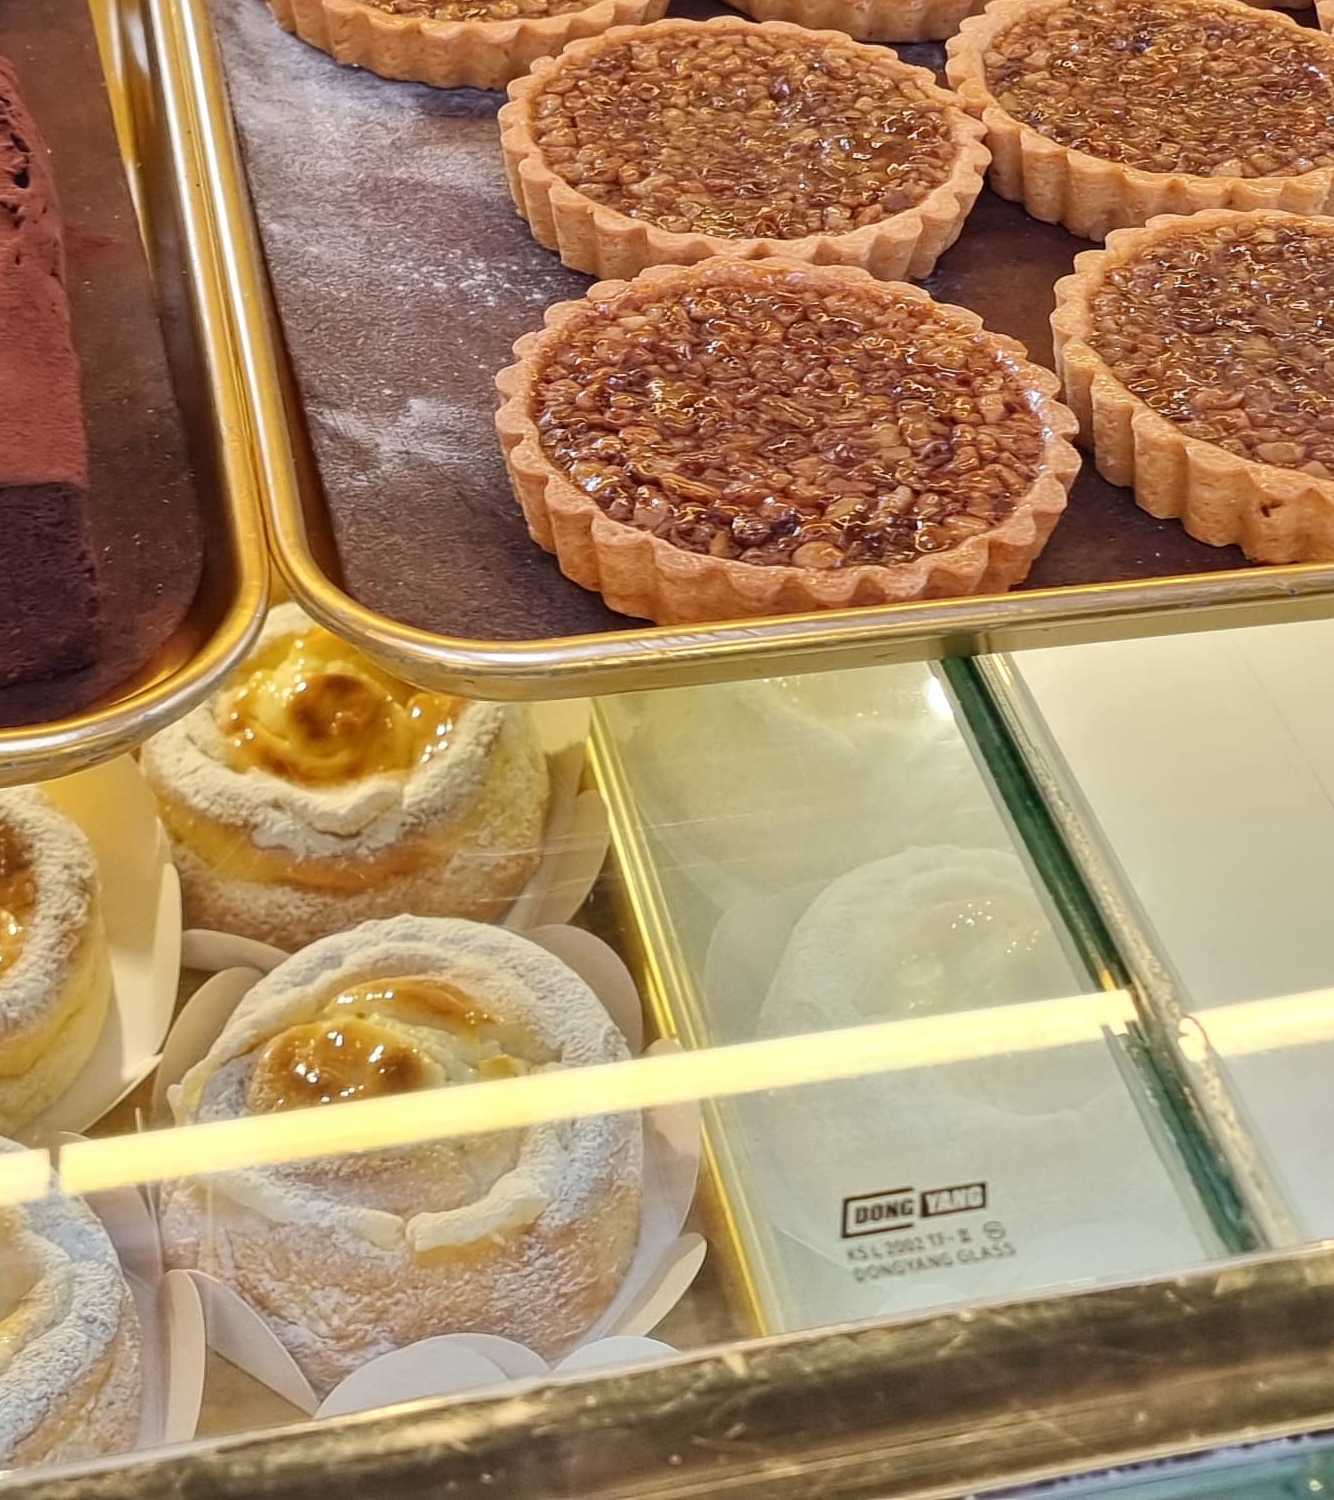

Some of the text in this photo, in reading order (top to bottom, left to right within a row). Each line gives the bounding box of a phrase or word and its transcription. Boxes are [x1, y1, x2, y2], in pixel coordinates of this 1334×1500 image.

[854, 1184, 983, 1225] DONG YANG
[853, 1240, 1017, 1283] DONGYANG GLASS
